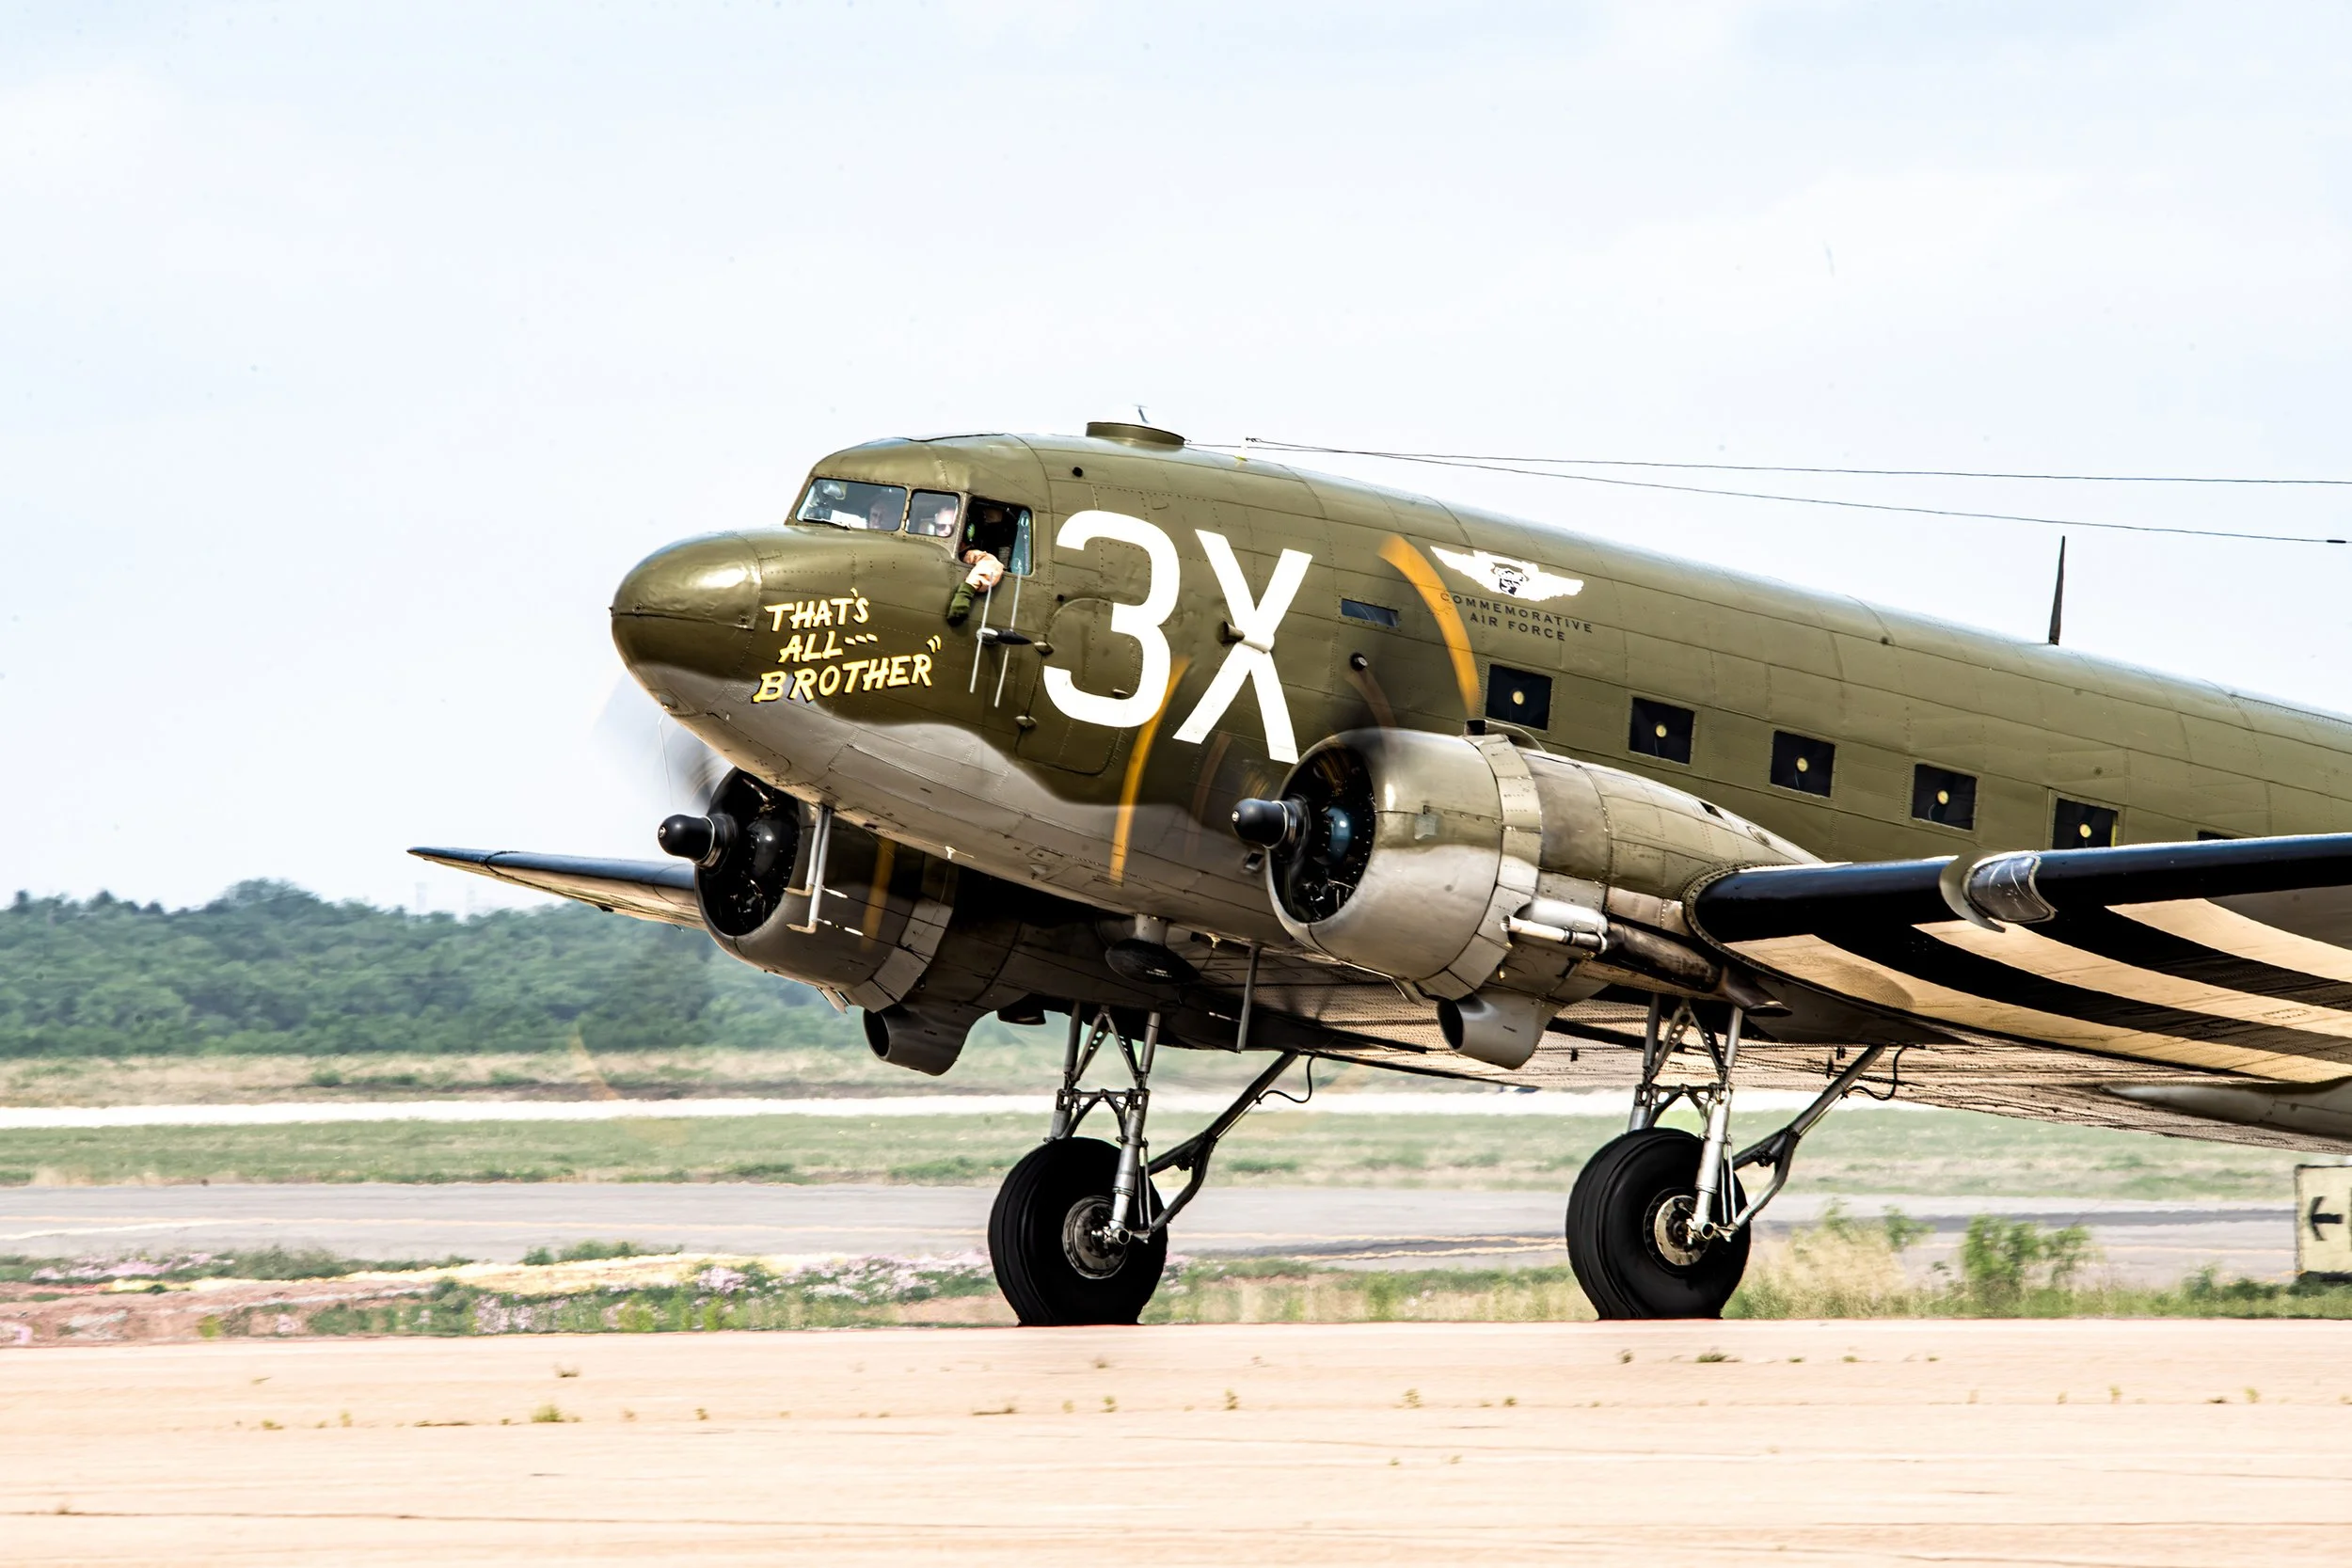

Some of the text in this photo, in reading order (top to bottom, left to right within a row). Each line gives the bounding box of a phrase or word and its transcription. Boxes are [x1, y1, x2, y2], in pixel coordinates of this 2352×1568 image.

[765, 588, 869, 632] THAT'S
[1440, 593, 1593, 633] COMMEMORATIVE
[1470, 612, 1565, 641] AIR FORCE
[1043, 510, 1313, 764] 3X
